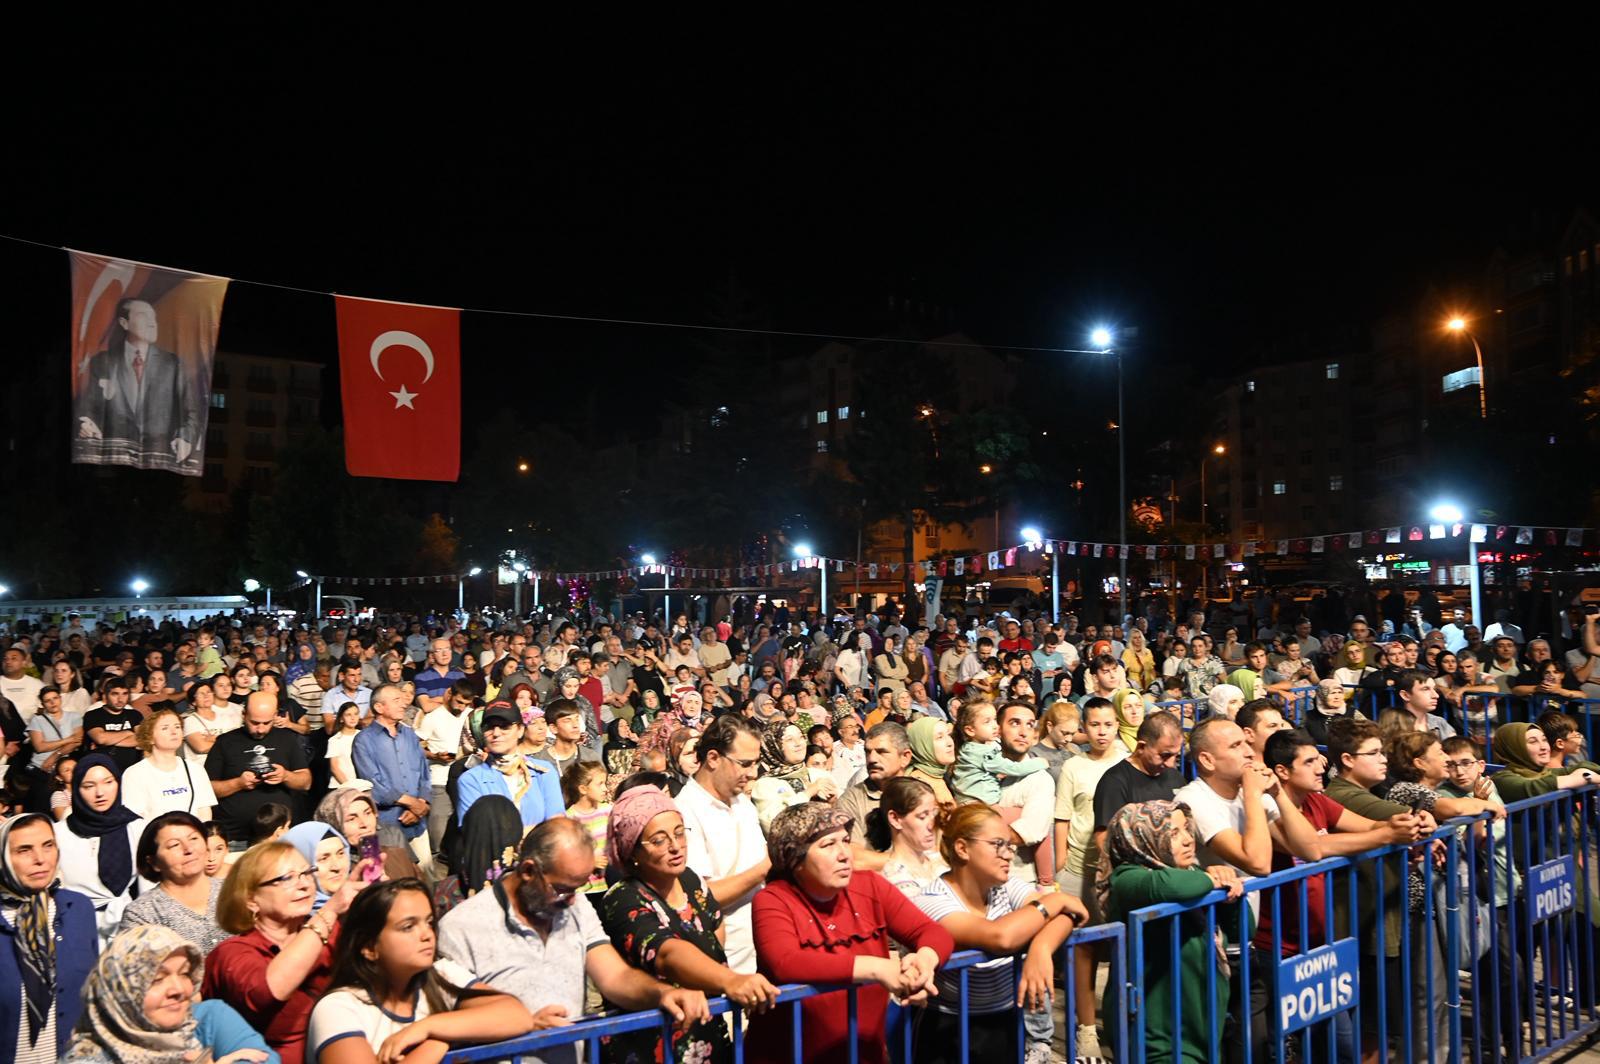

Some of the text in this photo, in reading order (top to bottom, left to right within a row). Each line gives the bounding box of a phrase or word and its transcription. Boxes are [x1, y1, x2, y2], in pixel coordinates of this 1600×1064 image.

[1540, 863, 1566, 884] KONYA
[1536, 879, 1572, 919] POLİS
[1295, 951, 1338, 983] KONYA
[1281, 970, 1353, 1031] POLİS
